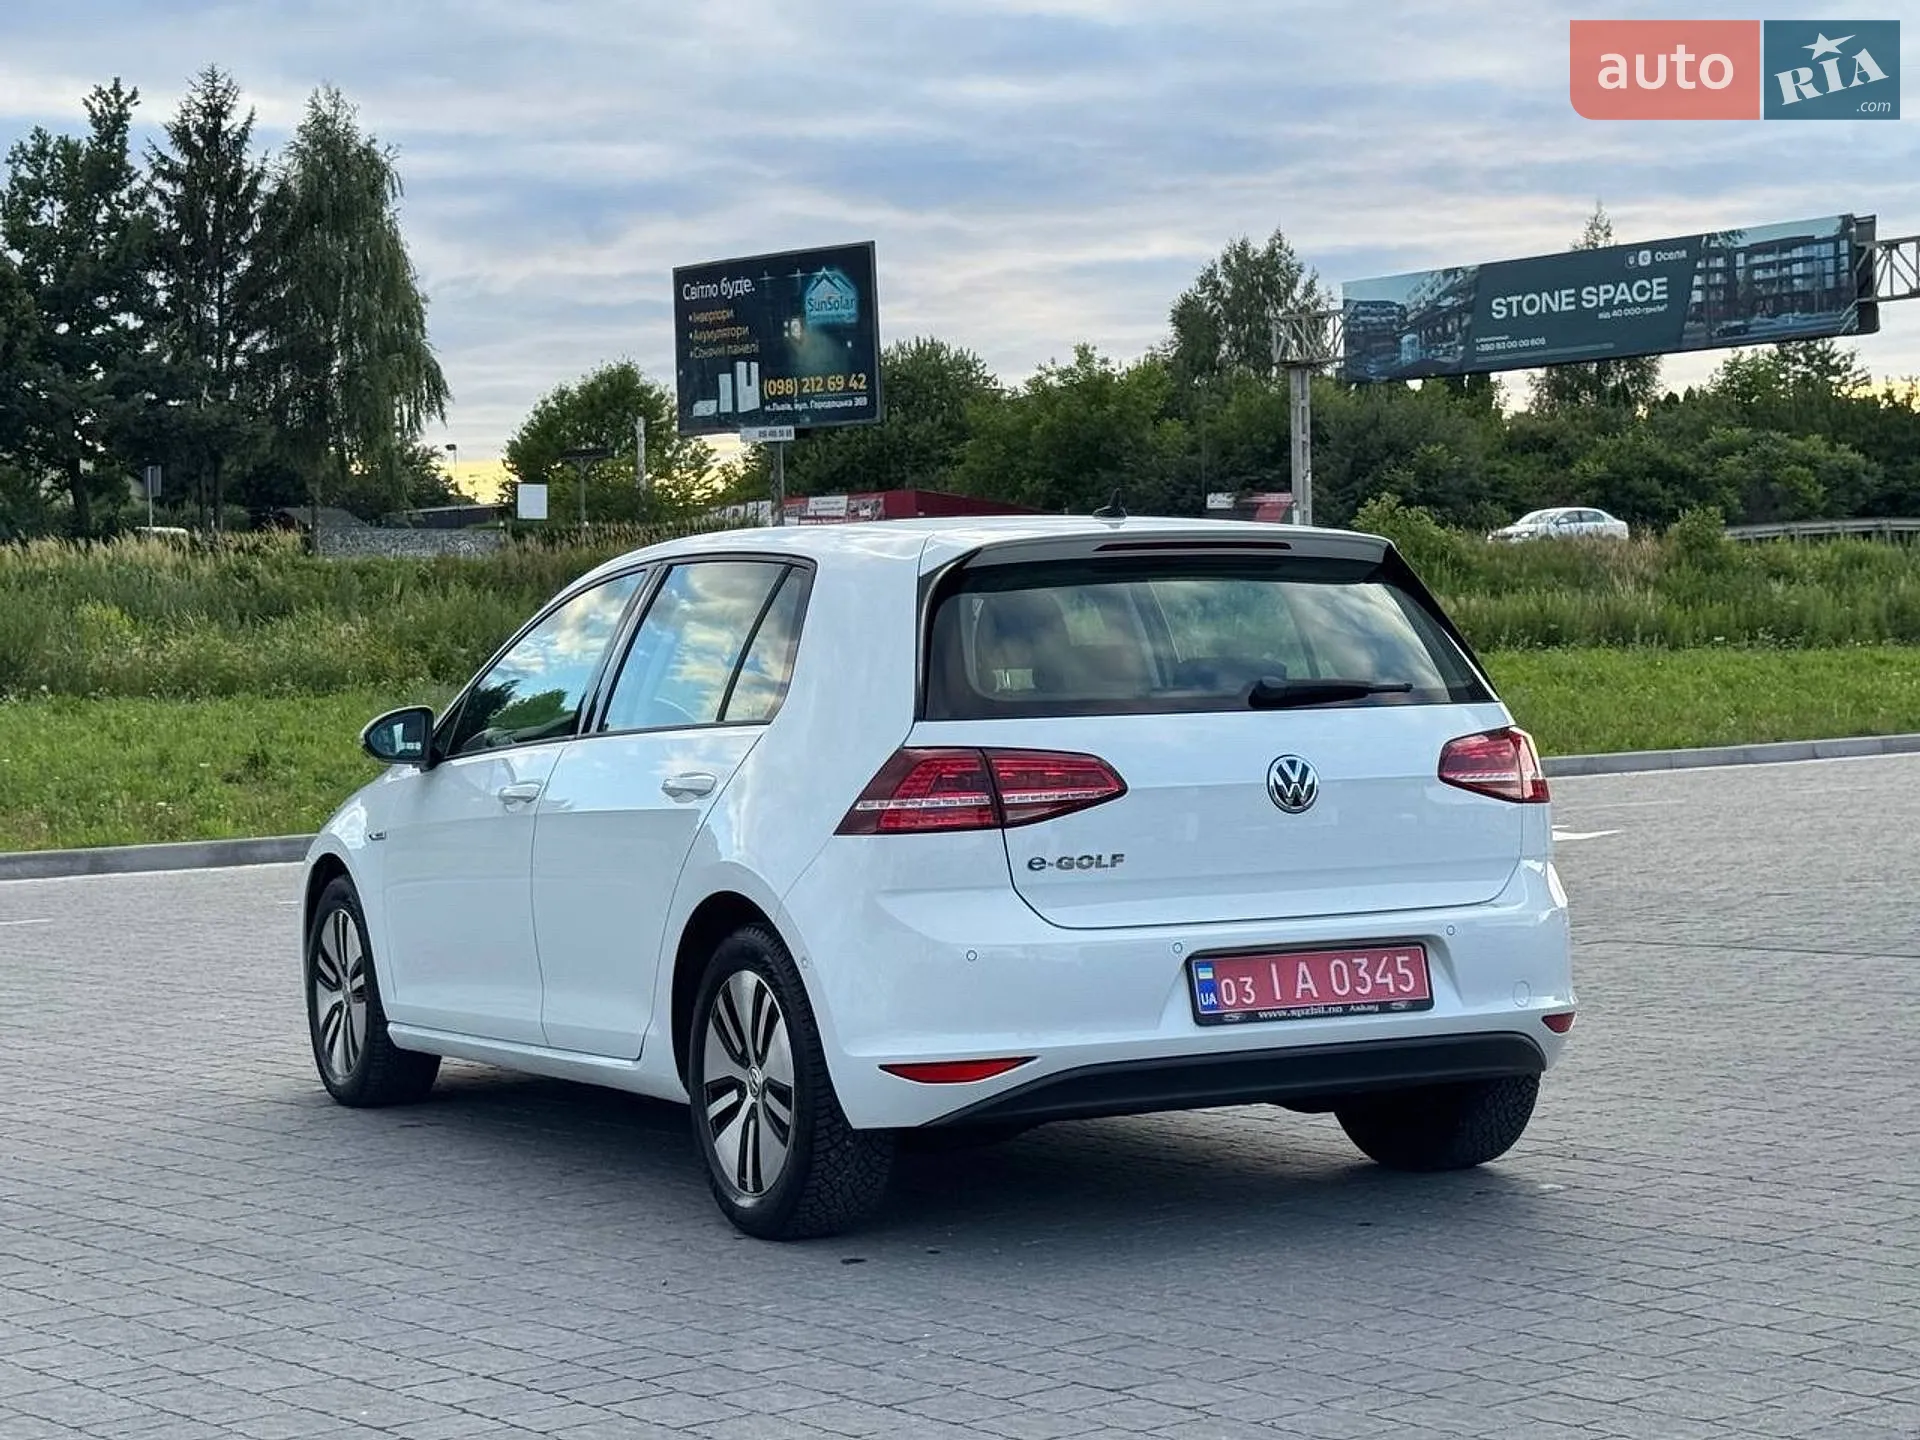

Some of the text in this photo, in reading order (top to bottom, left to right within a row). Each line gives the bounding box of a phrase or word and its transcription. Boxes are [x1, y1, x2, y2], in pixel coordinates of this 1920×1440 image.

[682, 281, 718, 301] Світло
[1491, 277, 1669, 319] STONE SPACE
[807, 296, 856, 312] SunSolar
[763, 372, 867, 400] (098) 212 69 42
[1027, 853, 1125, 872] e-GOLF
[1220, 975, 1256, 1007] 03
[1329, 955, 1416, 997] 0345
[1200, 990, 1218, 1006] UA
